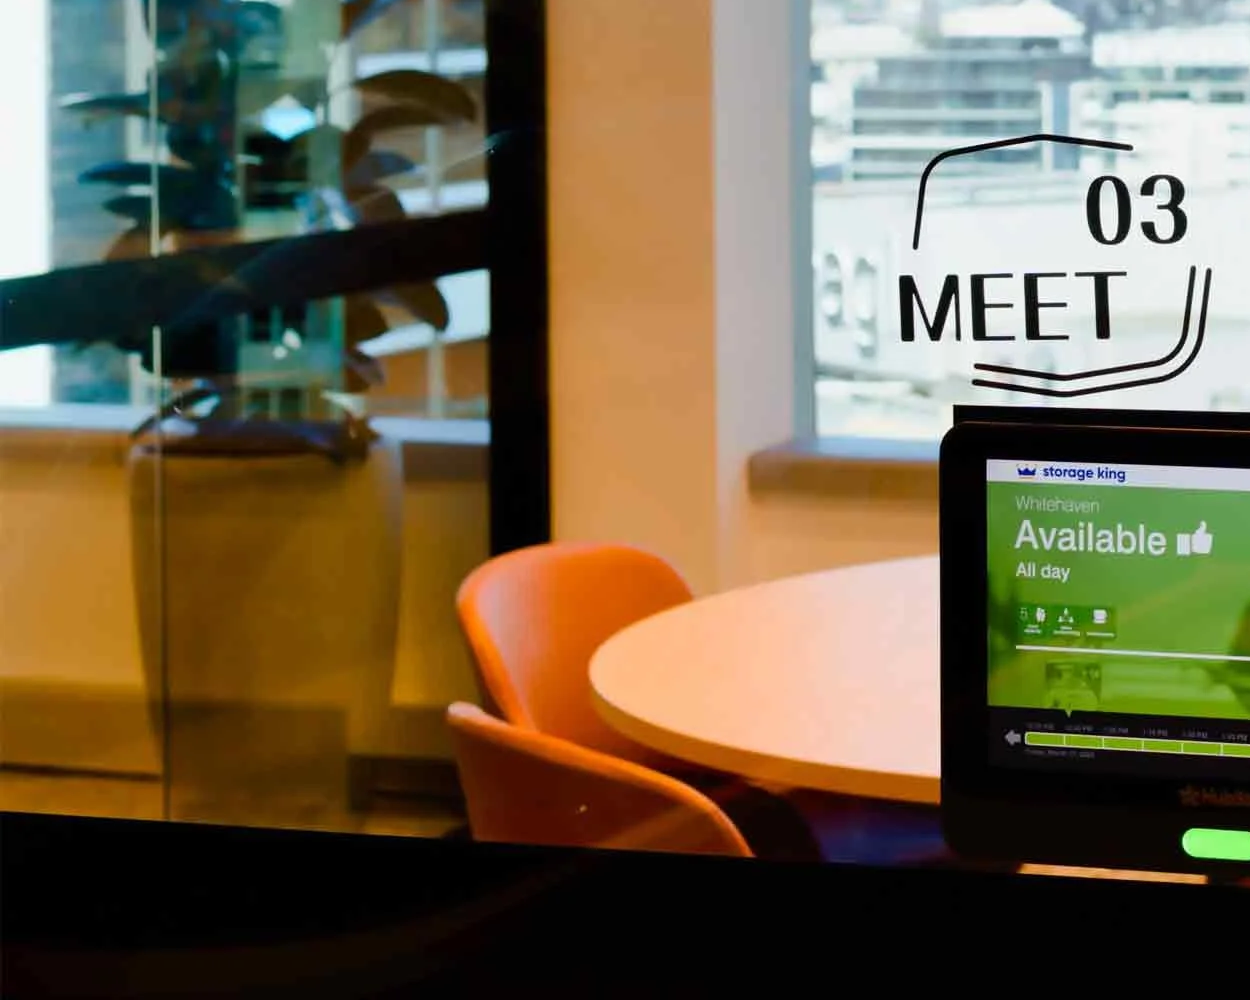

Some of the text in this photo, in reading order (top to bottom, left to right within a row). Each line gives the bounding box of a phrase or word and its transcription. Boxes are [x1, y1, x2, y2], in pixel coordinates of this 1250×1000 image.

[1086, 174, 1188, 245] 03
[899, 271, 1127, 342] MEET
[1042, 467, 1126, 482] storage king
[1015, 495, 1100, 514] Whitehaven
[1014, 519, 1167, 555] Available
[1016, 562, 1070, 582] All day
